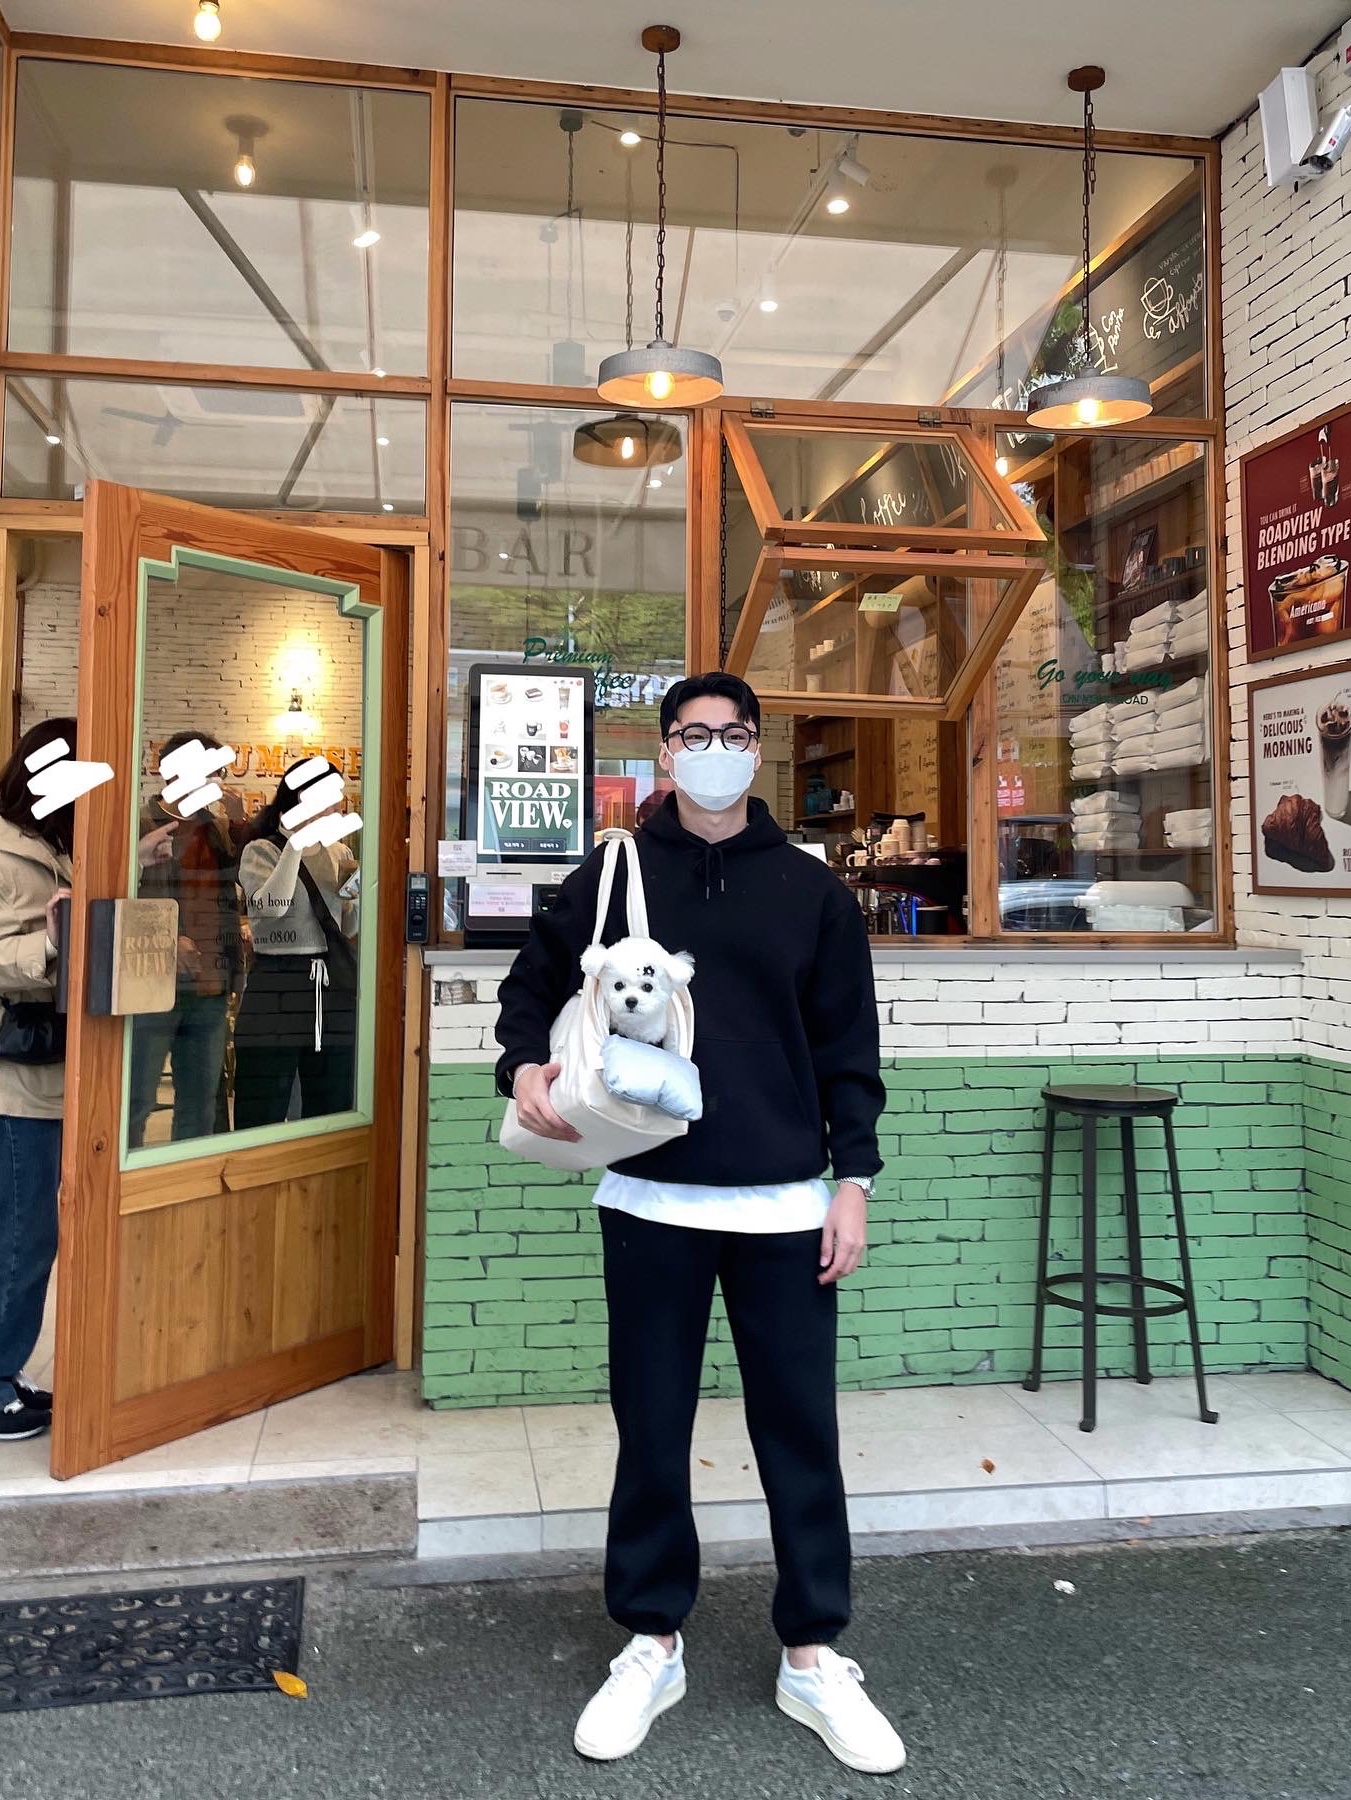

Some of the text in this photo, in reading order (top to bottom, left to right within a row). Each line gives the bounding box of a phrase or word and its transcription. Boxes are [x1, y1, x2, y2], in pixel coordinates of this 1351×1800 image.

[1258, 506, 1323, 549] ROADVIEW
[1269, 511, 1279, 523] CAN
[451, 525, 596, 578] BAR
[1256, 518, 1351, 571] BLENDING TYPE
[1289, 600, 1327, 619] Americano
[522, 636, 615, 664] Premium
[1037, 658, 1066, 690] Go
[1073, 670, 1121, 690] your
[1263, 718, 1304, 738] DELICIOUS
[1263, 736, 1312, 759] MORNING
[490, 781, 572, 799] ROAD
[267, 892, 296, 908] hours
